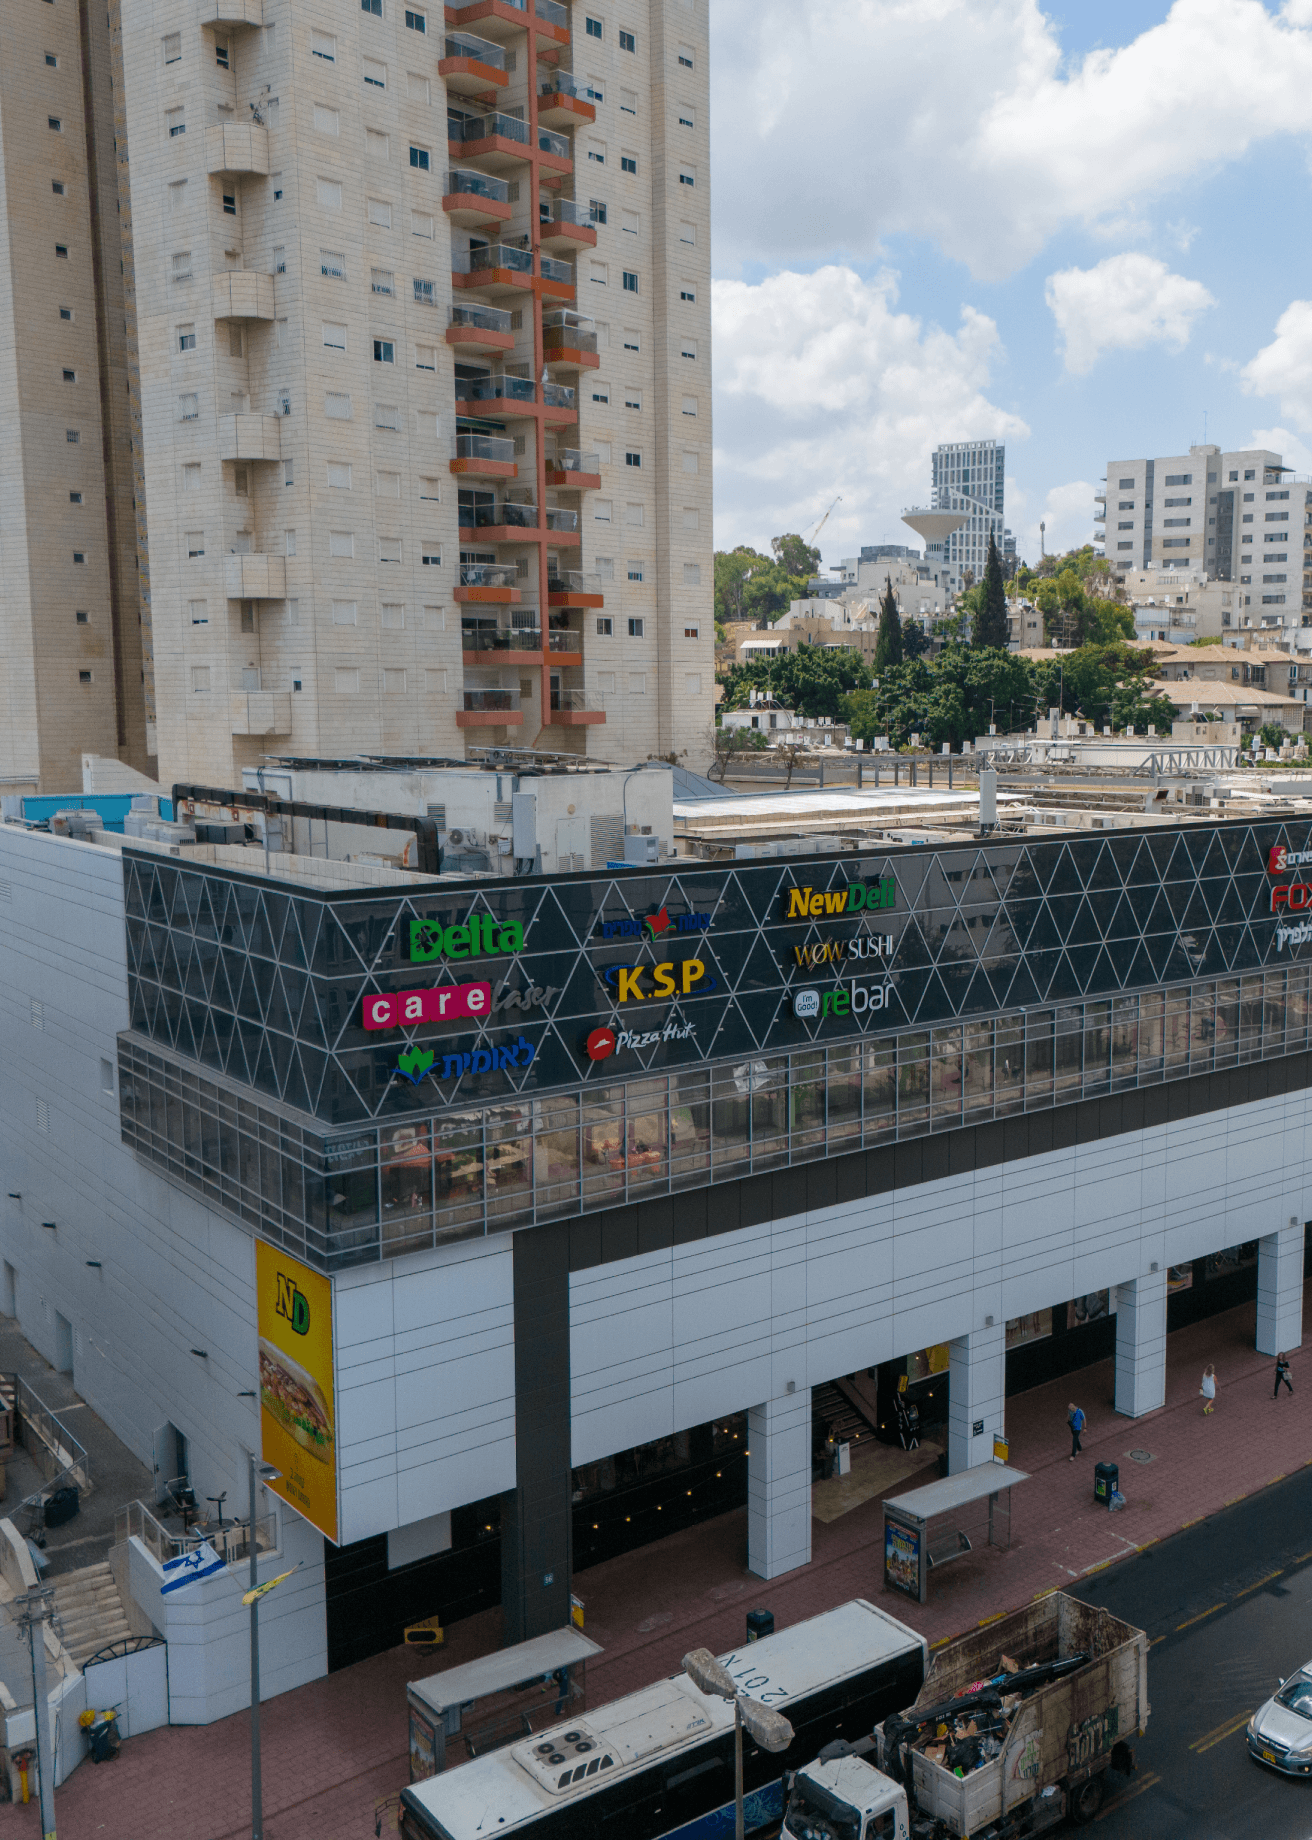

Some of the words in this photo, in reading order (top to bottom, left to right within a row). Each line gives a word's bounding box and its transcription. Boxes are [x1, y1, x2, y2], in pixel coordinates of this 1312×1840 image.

[410, 914, 524, 963] Delta
[602, 920, 642, 939] ספרים
[678, 913, 711, 931] צומת
[848, 934, 894, 960] SUSHI
[371, 988, 485, 1023] care
[615, 1029, 660, 1055] Pizza
[662, 1022, 696, 1042] Hut
[442, 1036, 535, 1079] לאומית
